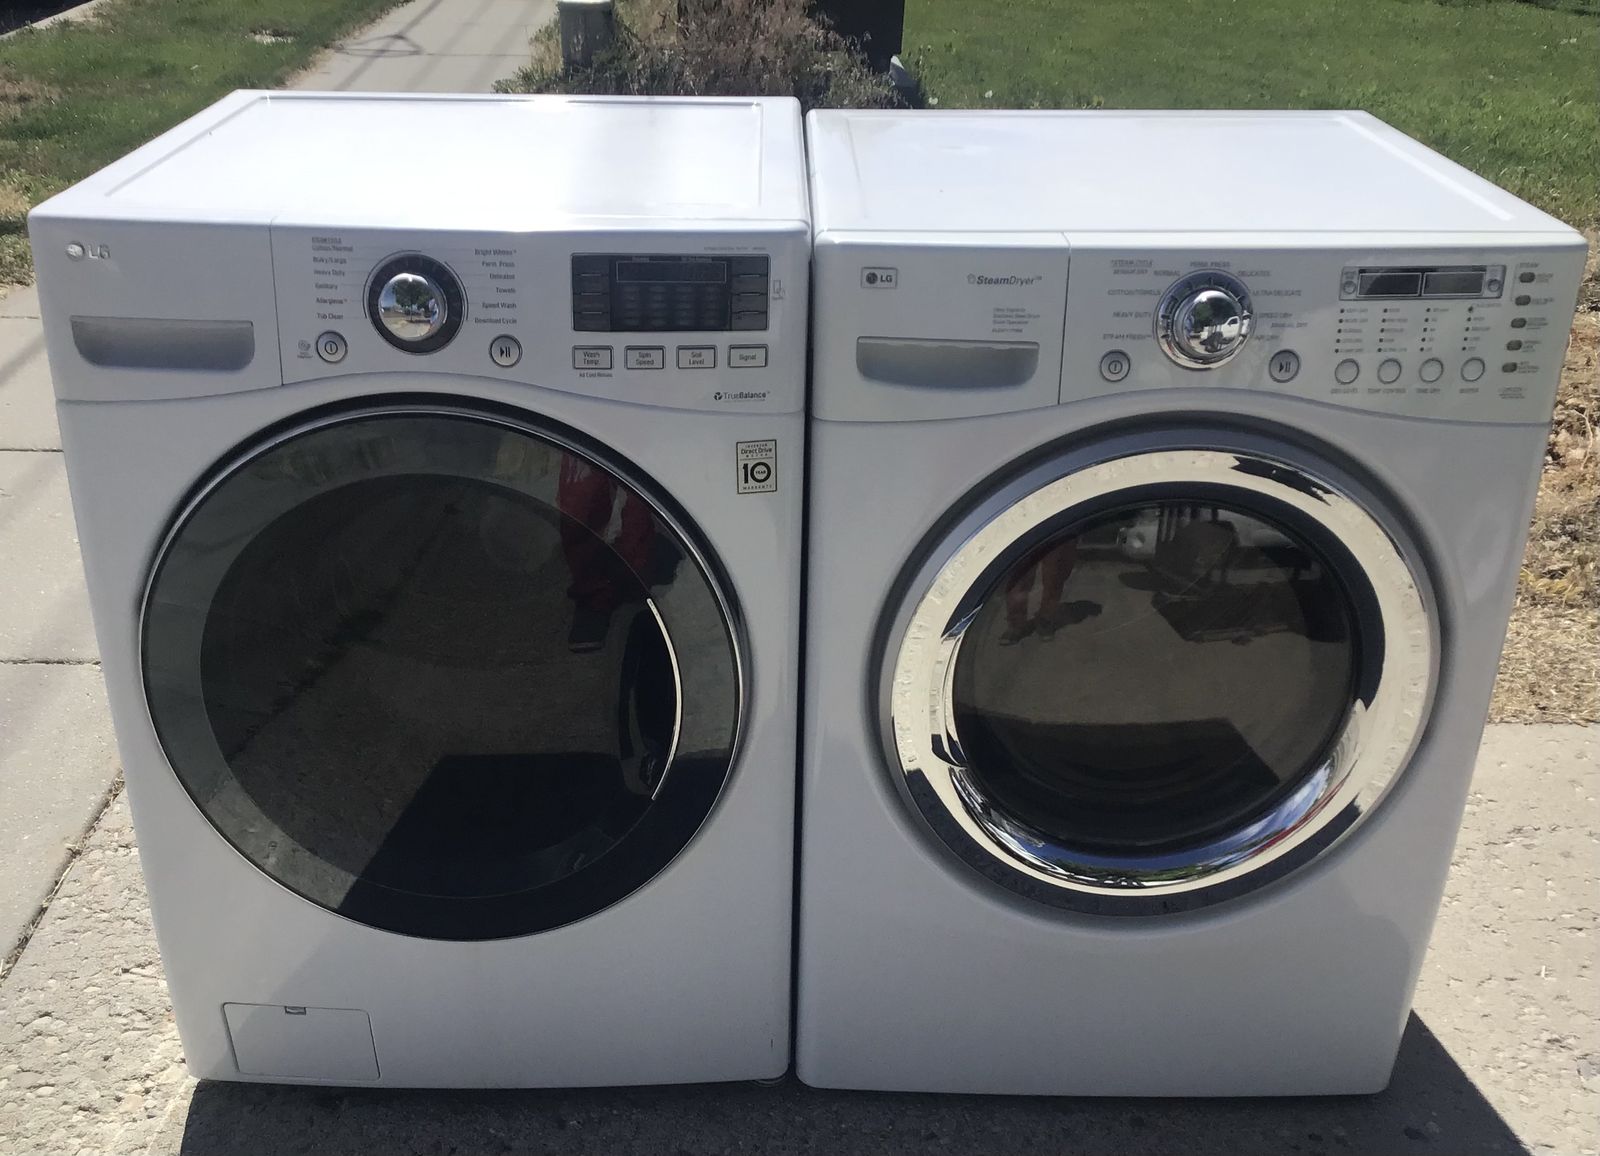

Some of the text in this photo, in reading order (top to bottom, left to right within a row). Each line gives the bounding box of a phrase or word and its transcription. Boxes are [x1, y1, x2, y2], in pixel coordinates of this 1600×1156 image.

[88, 245, 111, 259] LG
[474, 249, 492, 257] Bright
[880, 274, 893, 283] LG
[482, 301, 517, 309] Speed Wash
[329, 312, 344, 320] Clean
[502, 317, 517, 325] Cycle
[739, 353, 757, 361] Signal
[743, 462, 772, 485] 10
